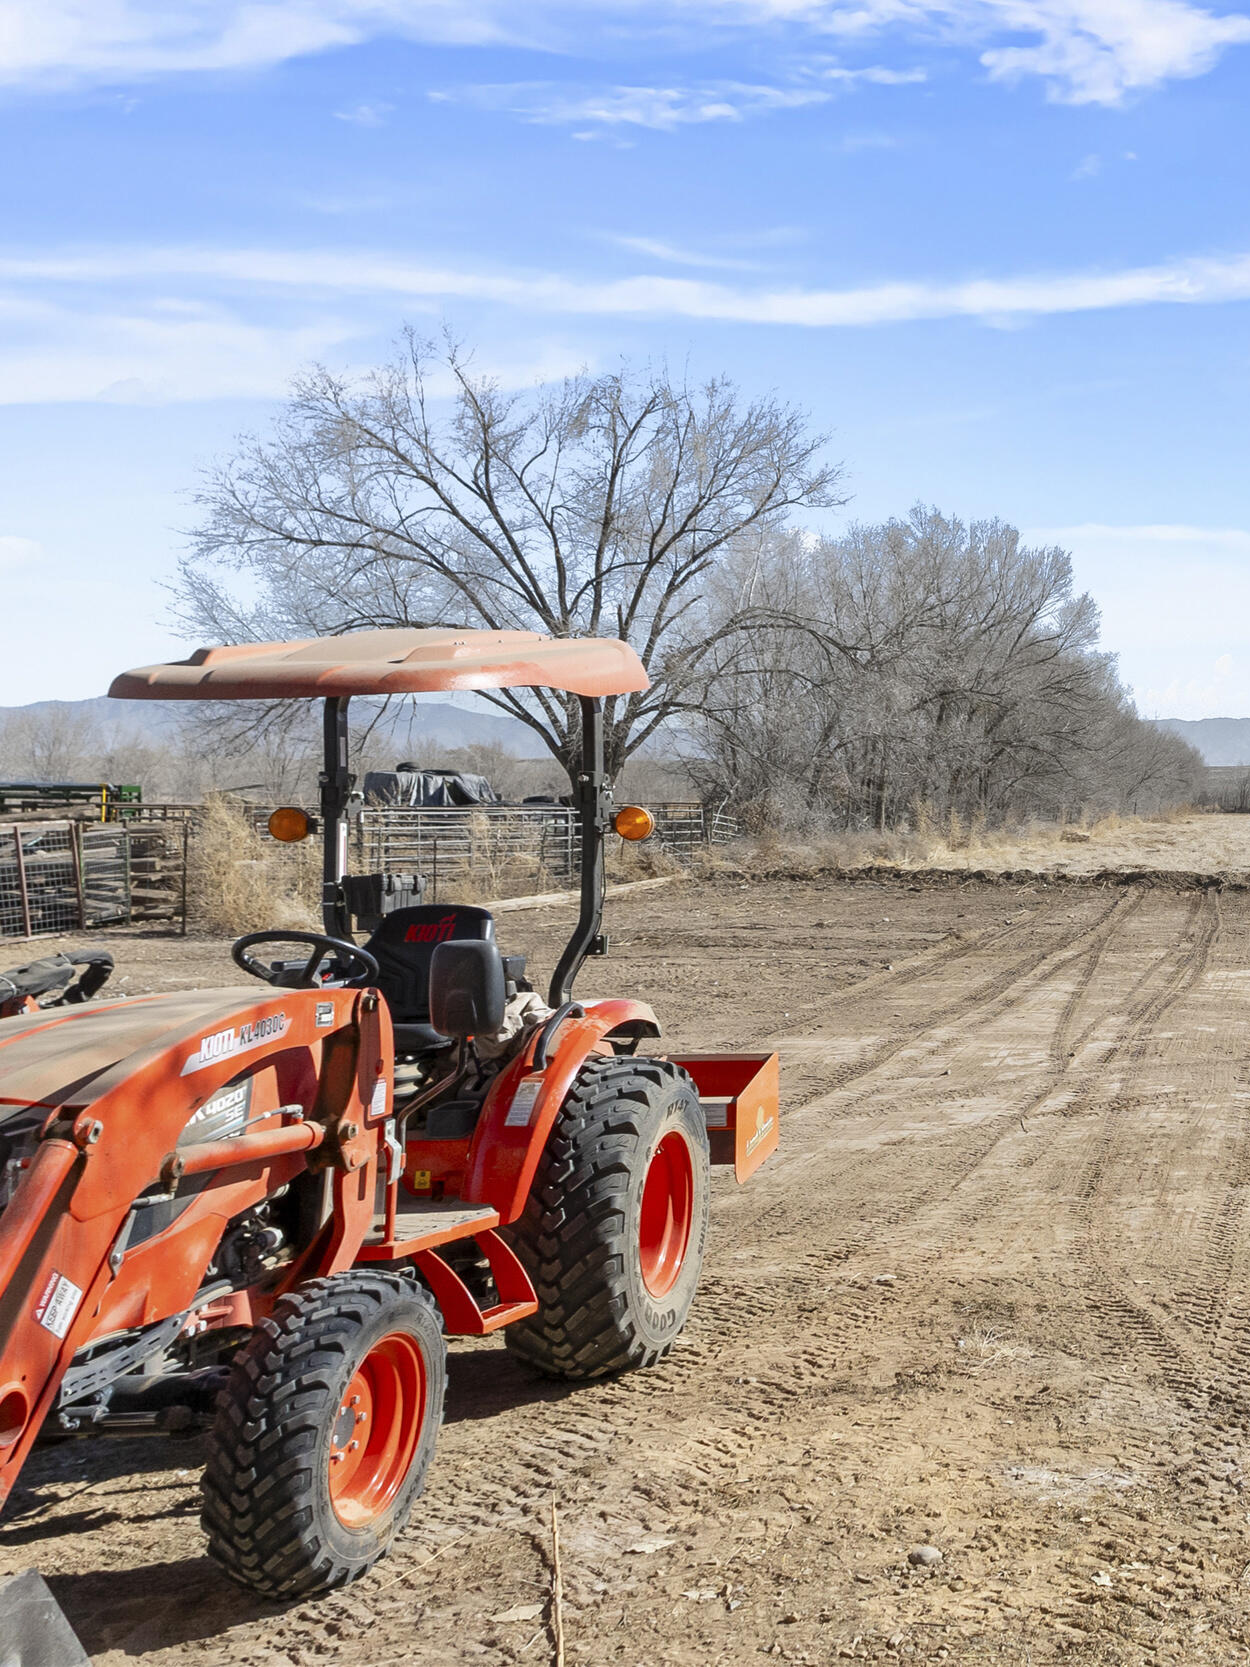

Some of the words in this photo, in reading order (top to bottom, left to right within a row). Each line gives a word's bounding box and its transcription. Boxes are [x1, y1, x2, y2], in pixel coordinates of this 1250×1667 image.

[404, 914, 456, 942] KIOTI
[200, 1027, 235, 1062] KIOTI
[239, 1011, 286, 1046] KL4030C
[186, 1086, 248, 1127] K4020
